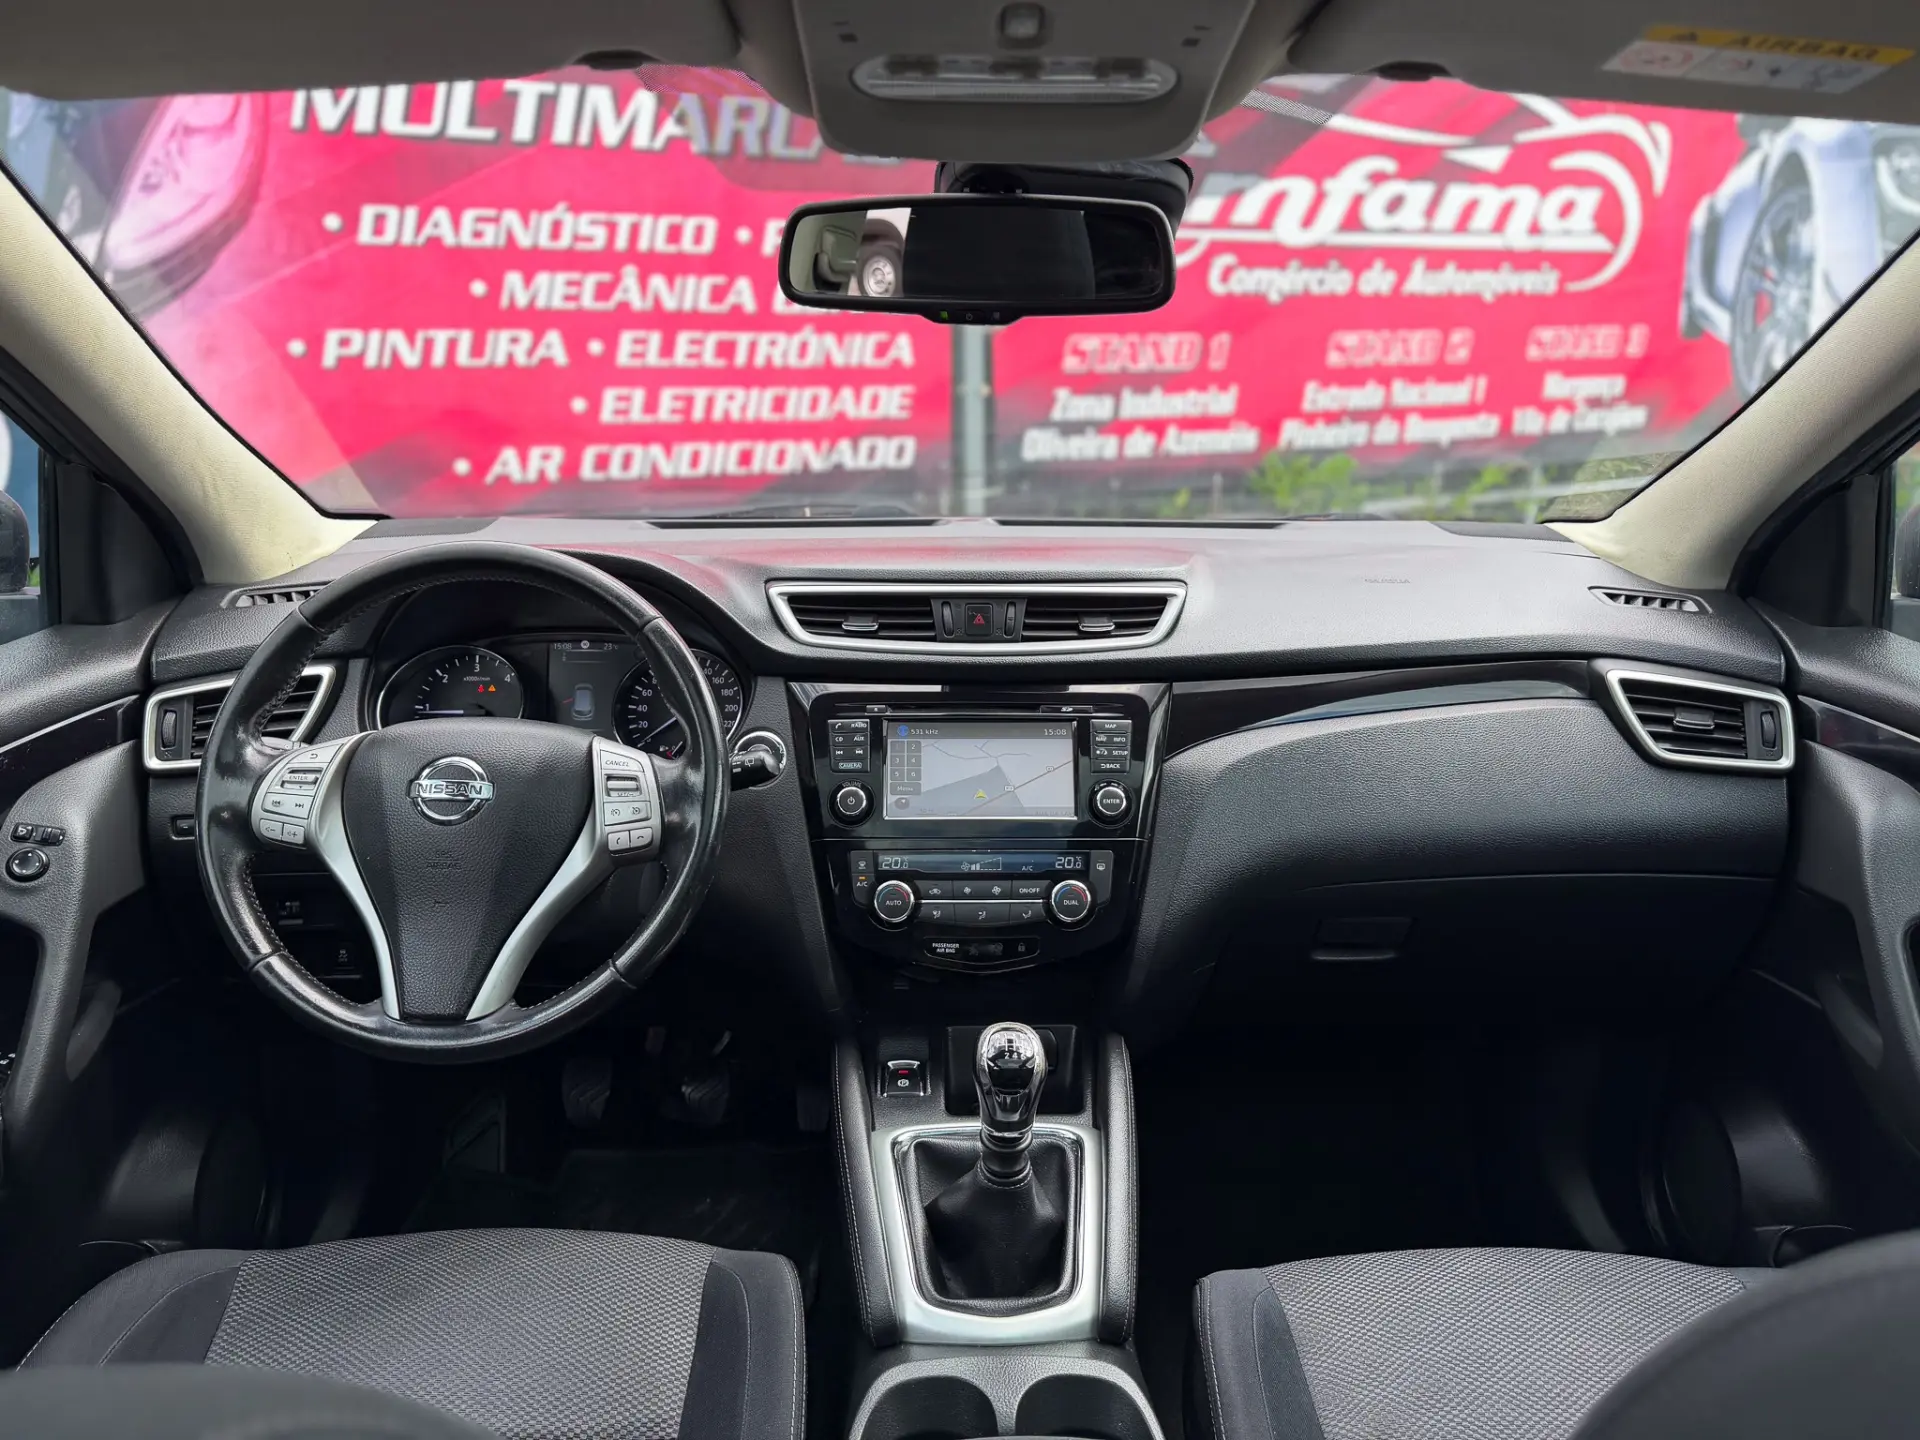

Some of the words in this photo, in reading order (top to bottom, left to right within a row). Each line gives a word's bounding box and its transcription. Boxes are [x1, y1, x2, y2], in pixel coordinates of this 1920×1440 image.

[290, 79, 906, 163] MULTIMARC
[356, 203, 717, 255] DIAGNÓSTICO
[1357, 258, 1398, 296] de
[500, 265, 757, 315] MECÂNICA
[321, 329, 568, 369] PINTURA
[615, 322, 915, 368] ELECTRÓNICA
[600, 385, 915, 425] ELETRICIDADE
[484, 446, 566, 485] AR
[578, 436, 917, 480] CONDICIONADO
[474, 663, 481, 673] 3
[442, 673, 450, 683] 2
[641, 689, 653, 697] 60
[721, 688, 734, 696] 180
[636, 704, 648, 712] 40
[725, 704, 739, 712] 200
[638, 720, 648, 729] 20
[1044, 728, 1067, 736] 15:08
[416, 783, 483, 796] NISSAN
